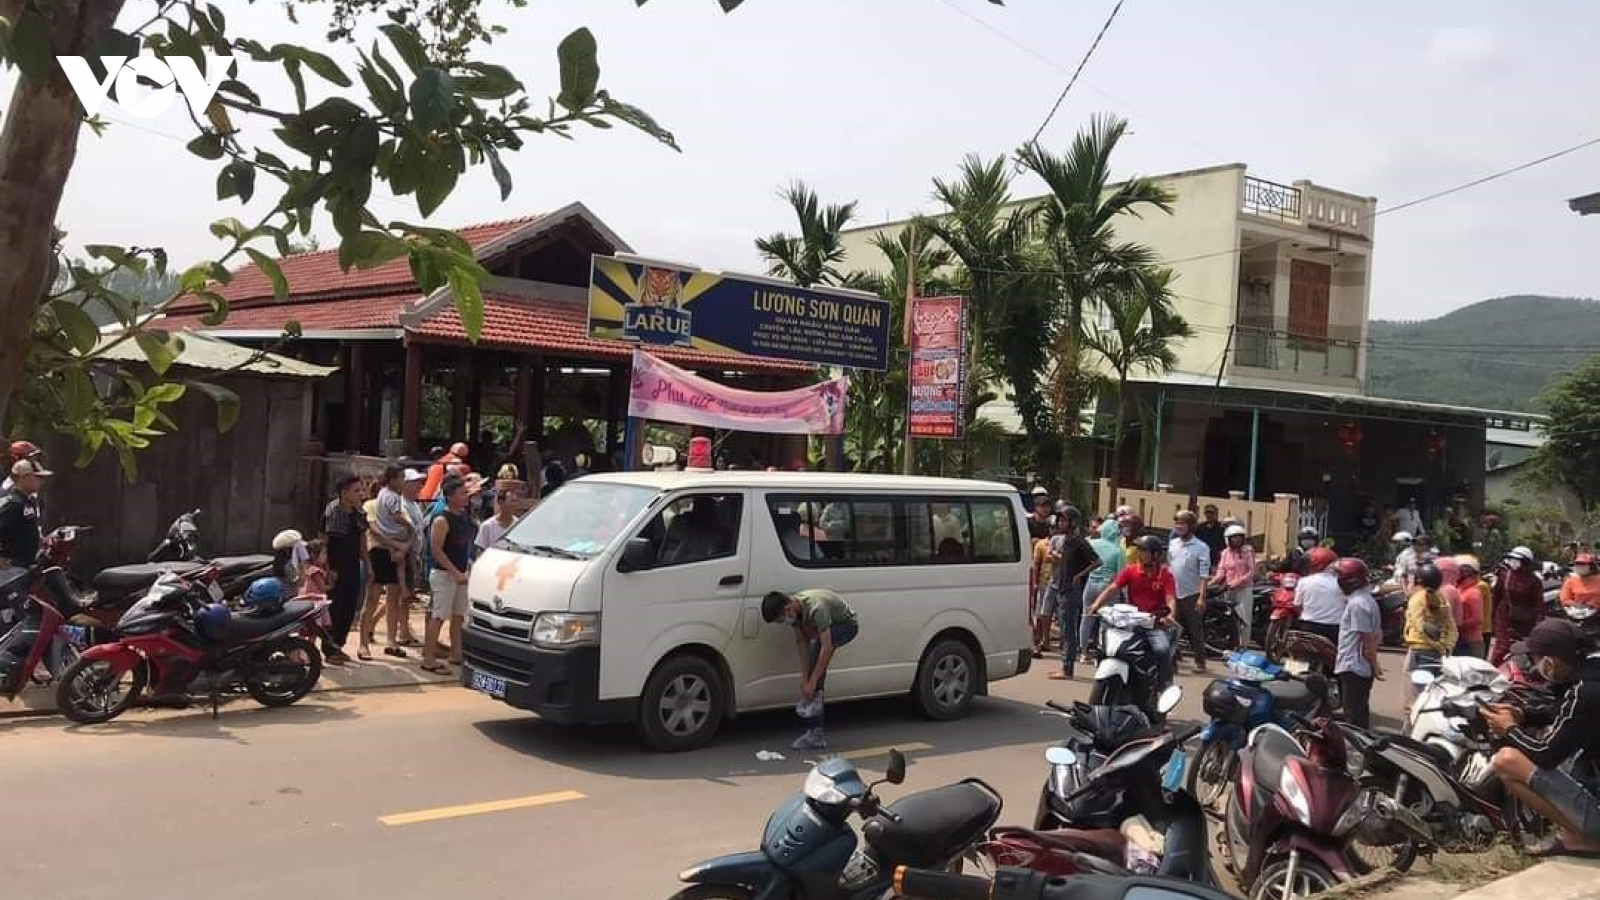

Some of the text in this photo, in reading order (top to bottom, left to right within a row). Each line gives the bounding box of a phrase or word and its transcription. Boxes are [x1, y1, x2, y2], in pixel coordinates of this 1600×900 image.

[625, 311, 689, 336] LARUE
[753, 289, 881, 327] LƯƠNG SƠN QUÁN
